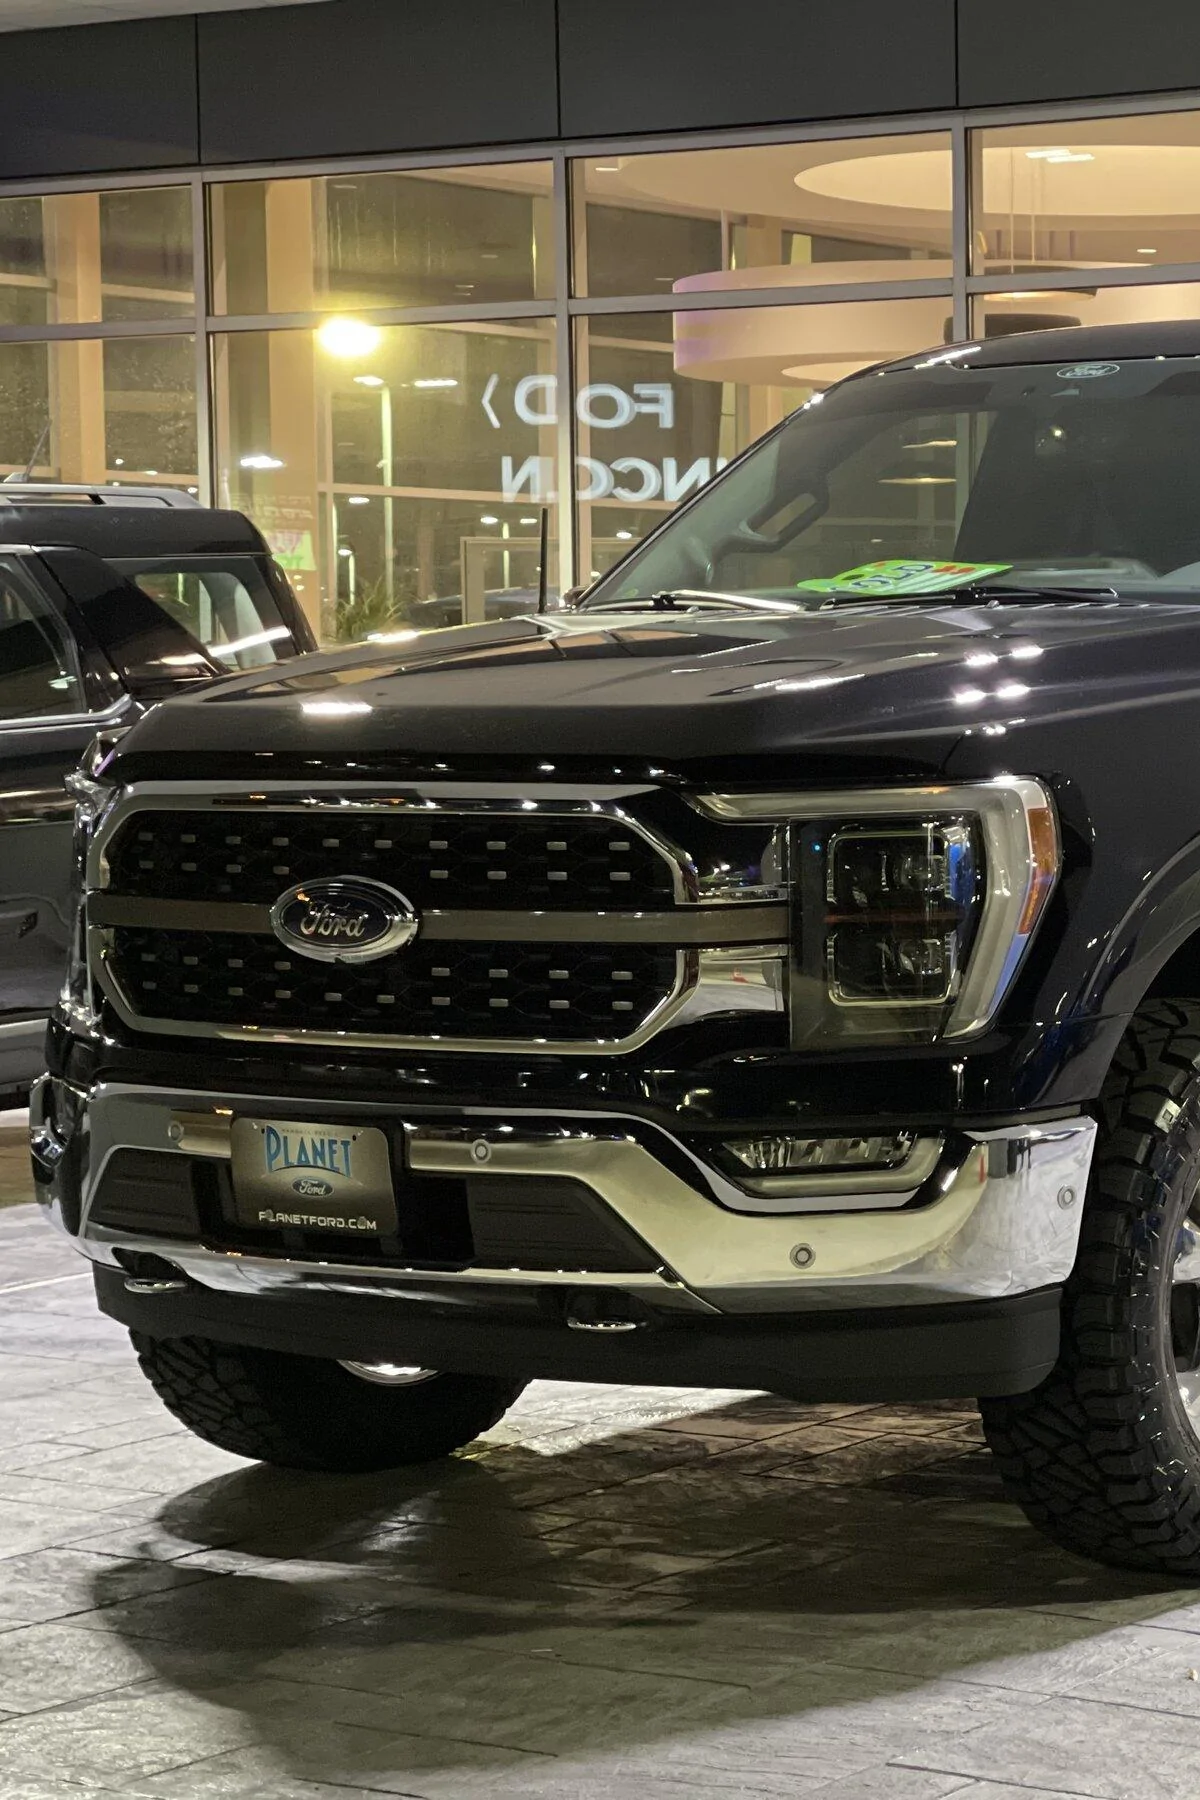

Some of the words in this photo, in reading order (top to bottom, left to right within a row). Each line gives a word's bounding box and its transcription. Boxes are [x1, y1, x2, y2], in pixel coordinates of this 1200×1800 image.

[300, 901, 370, 936] Ford
[265, 1125, 352, 1177] PLANET
[299, 1180, 326, 1195] Ford
